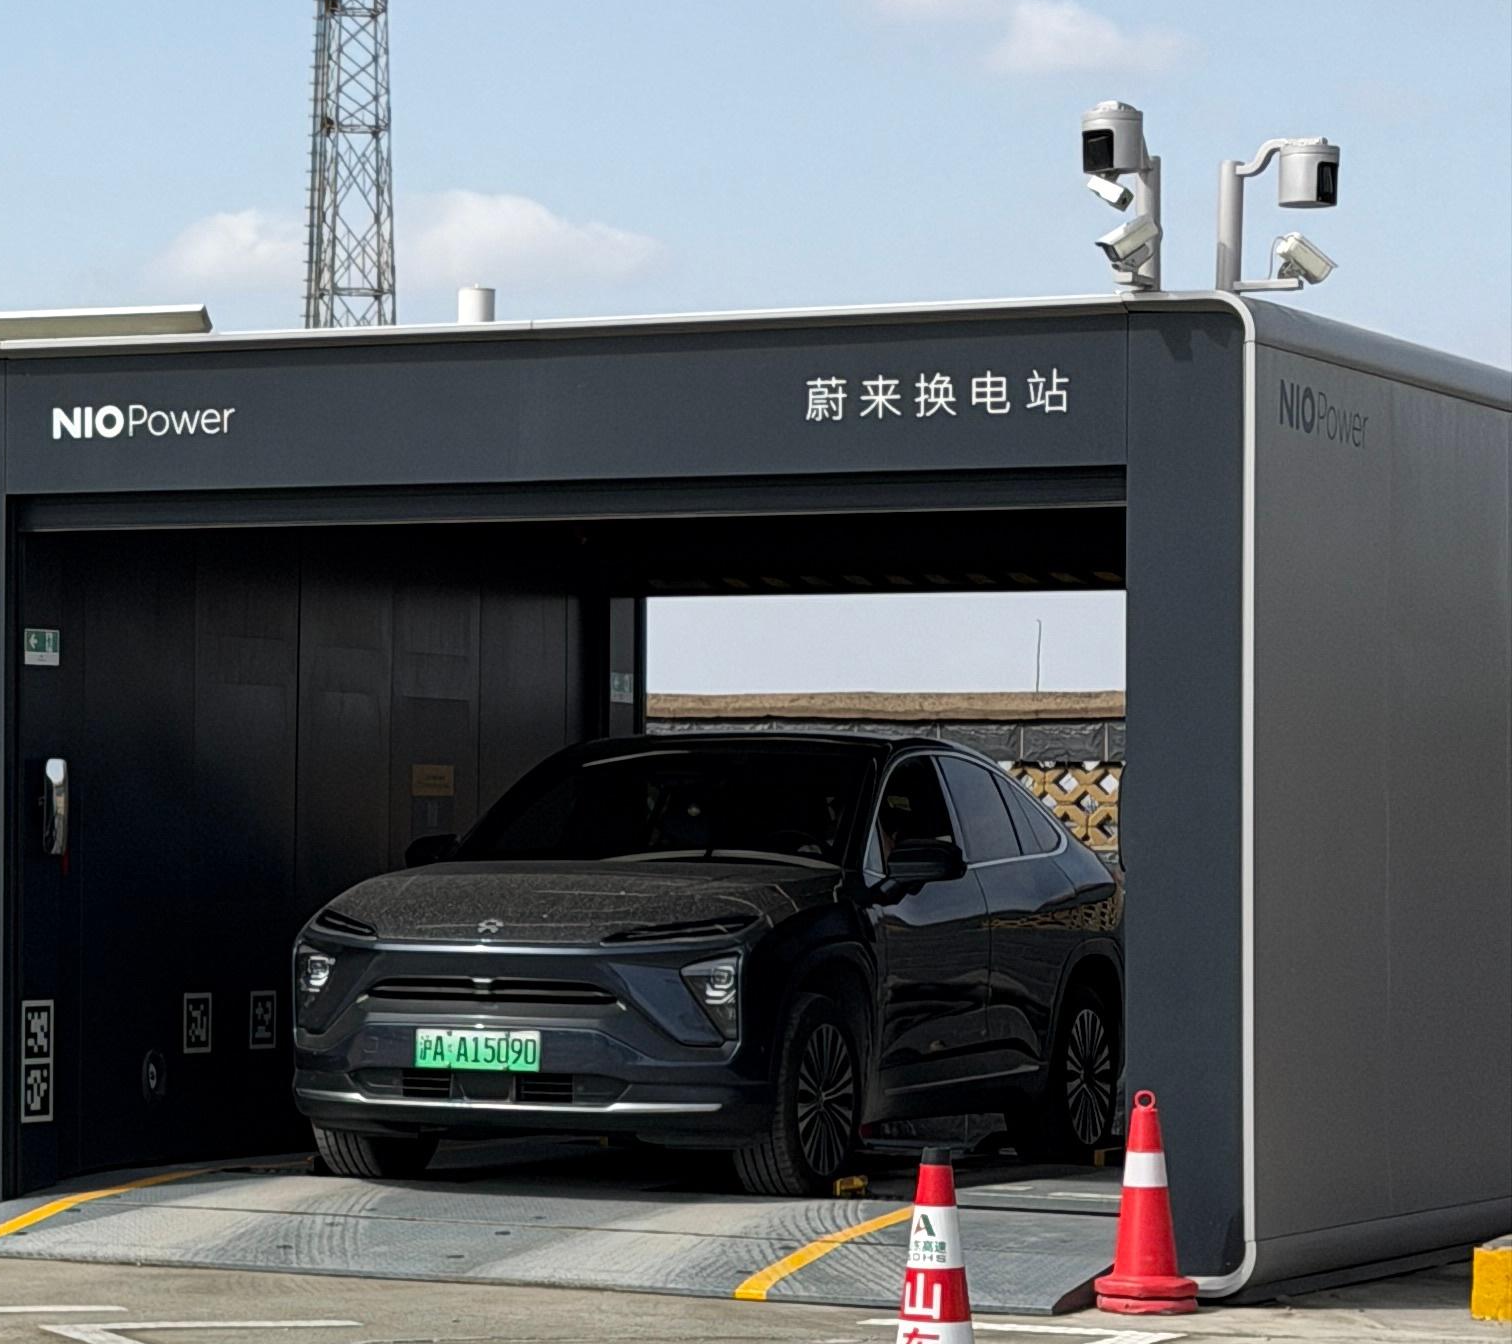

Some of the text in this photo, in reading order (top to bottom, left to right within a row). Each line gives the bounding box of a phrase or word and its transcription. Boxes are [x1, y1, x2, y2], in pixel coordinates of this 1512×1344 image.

[806, 368, 1070, 421] 蔚来换电站
[1279, 379, 1369, 449] NIOPower
[52, 404, 237, 440] NIOPower
